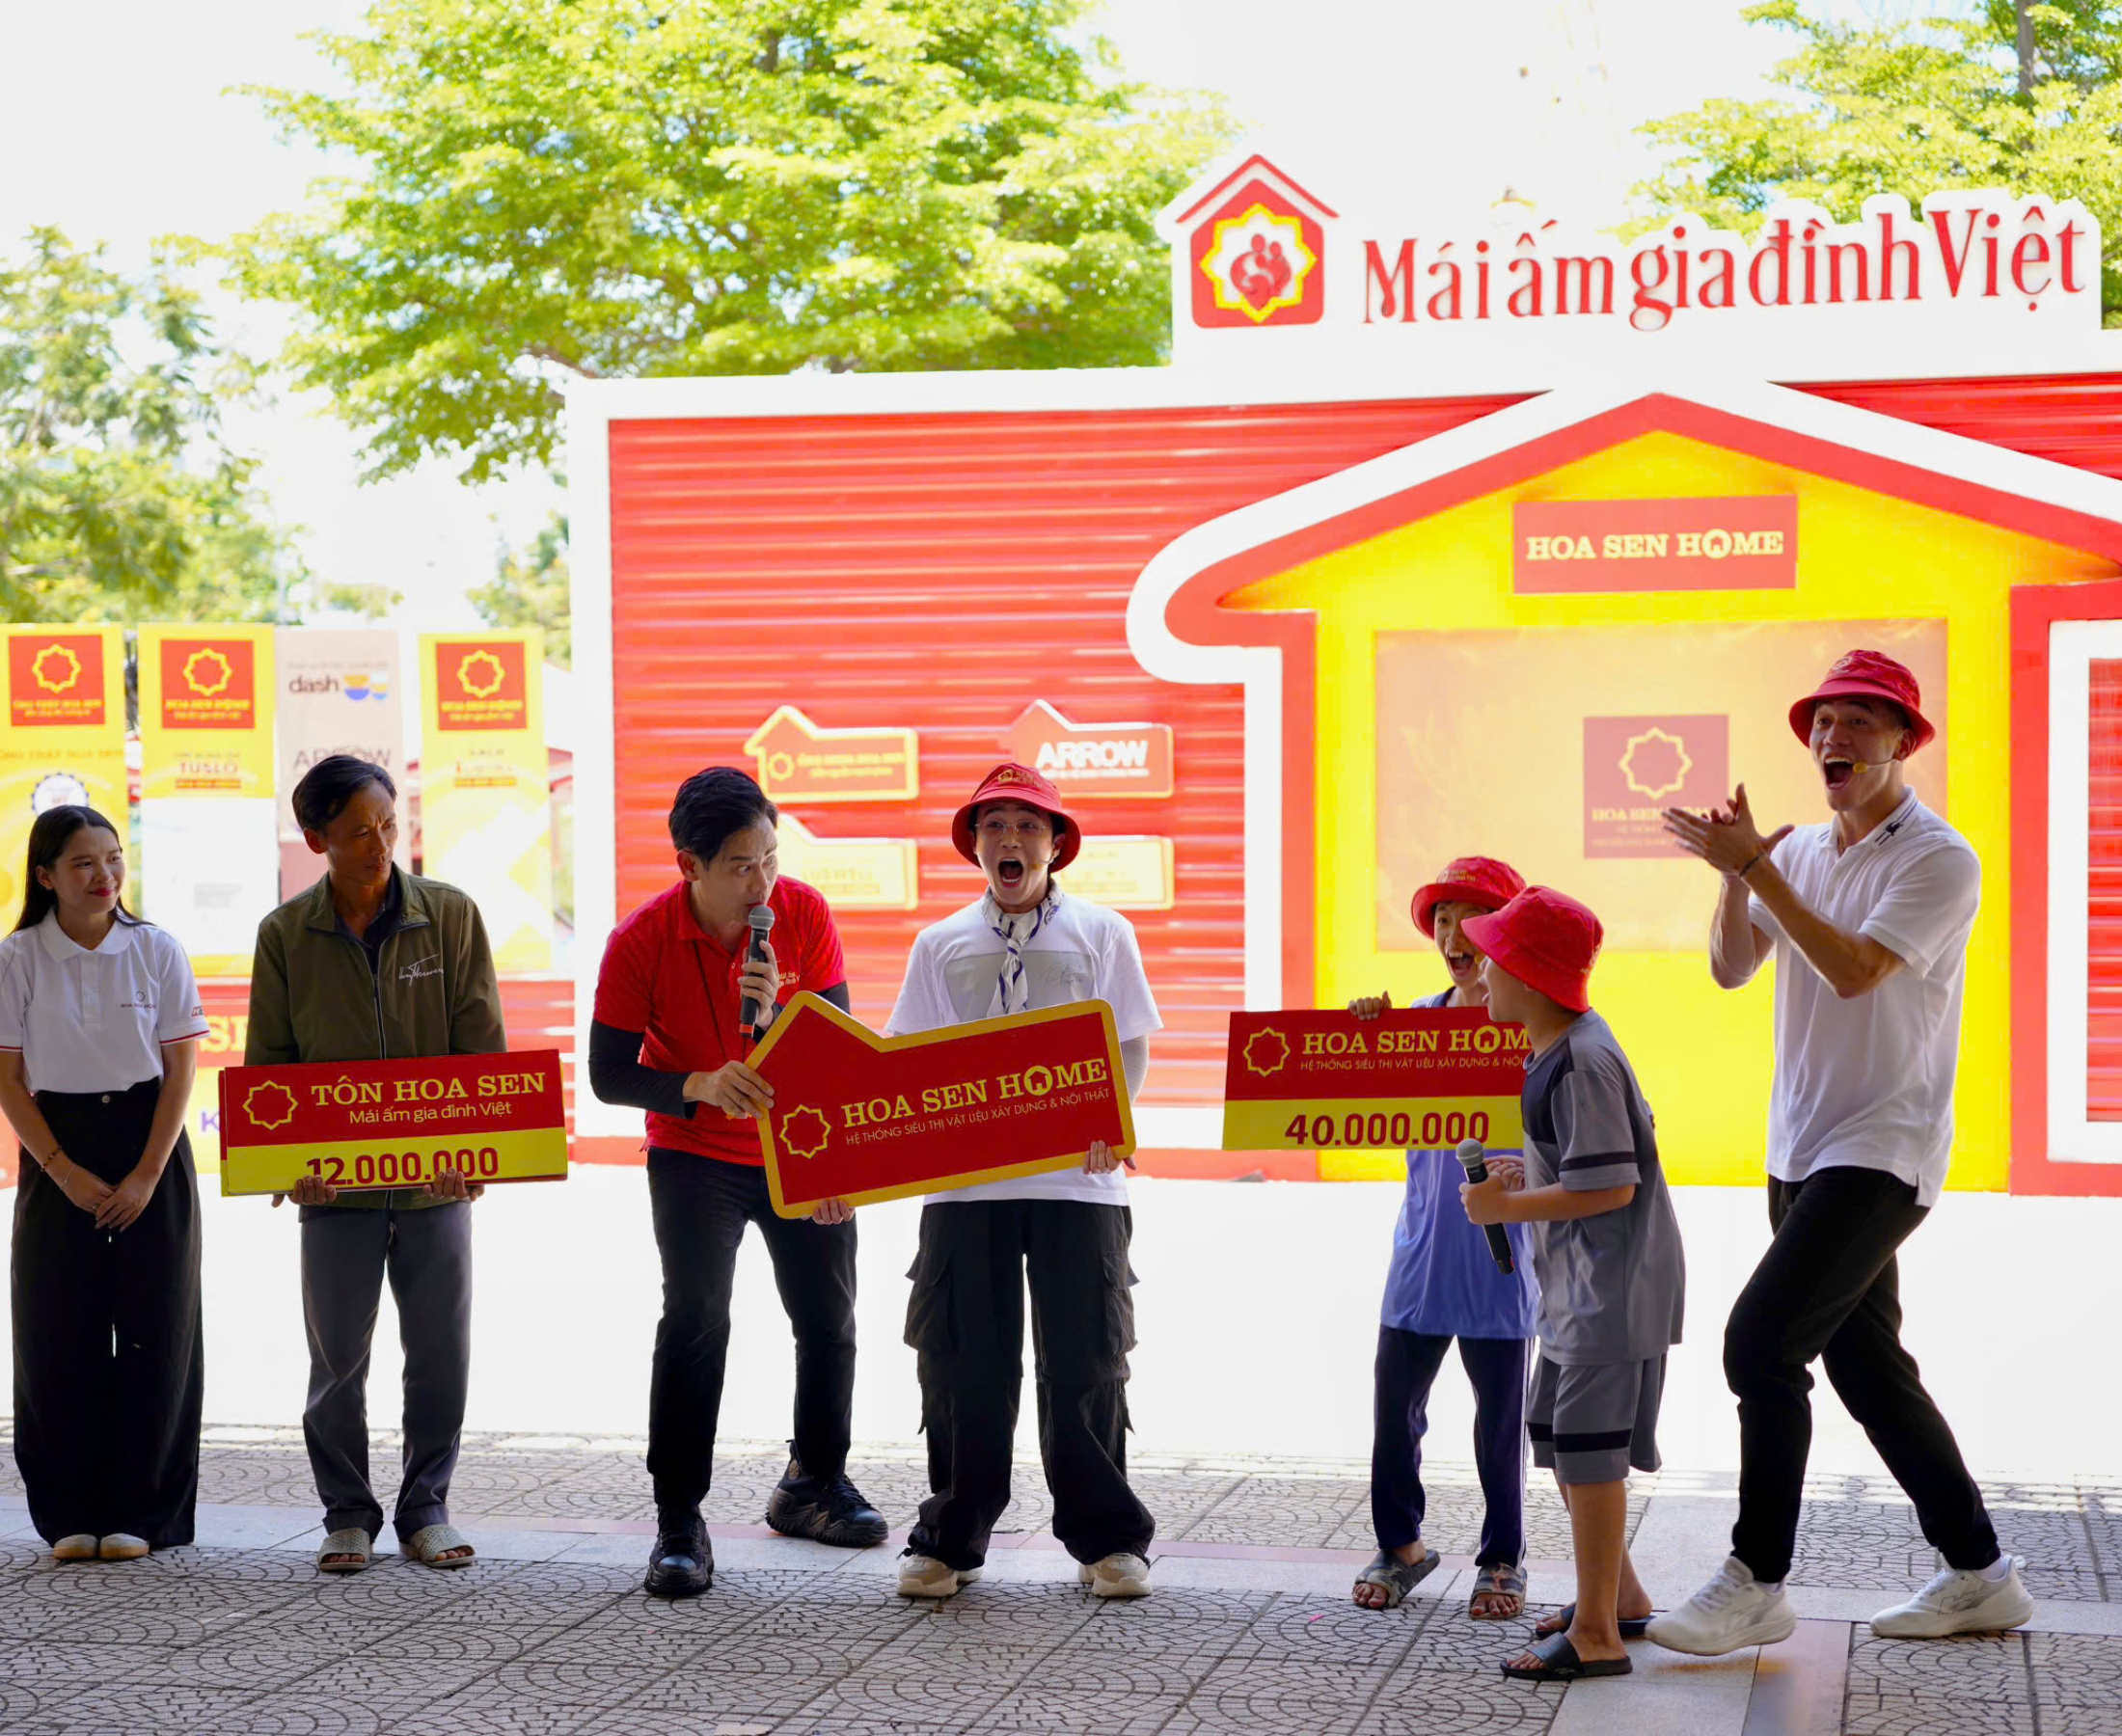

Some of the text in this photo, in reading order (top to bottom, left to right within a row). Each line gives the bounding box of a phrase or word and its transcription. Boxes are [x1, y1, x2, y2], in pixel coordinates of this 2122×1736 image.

[1361, 199, 2086, 332] Mái ấm gia đình Việt
[1526, 529, 1784, 561] HOA SEN HOME
[288, 674, 340, 693] dash
[1035, 740, 1149, 770] ARROW
[1302, 1024, 1532, 1055] HOA SEN HOM
[311, 1071, 546, 1106] TÔN HOA SEN
[841, 1057, 1108, 1128] HOA SEN HOME
[349, 1100, 513, 1124] Mái ấm gia đình Việt
[846, 1131, 861, 1146] HỆ
[862, 1126, 903, 1143] THỐNG
[904, 1121, 927, 1136] SIÊU
[991, 1105, 1013, 1120] XÂY
[1048, 1097, 1059, 1109] &
[1083, 1086, 1110, 1101] THẤT
[1284, 1110, 1490, 1147] 40.000.000
[306, 1146, 500, 1186] 12.000.000
